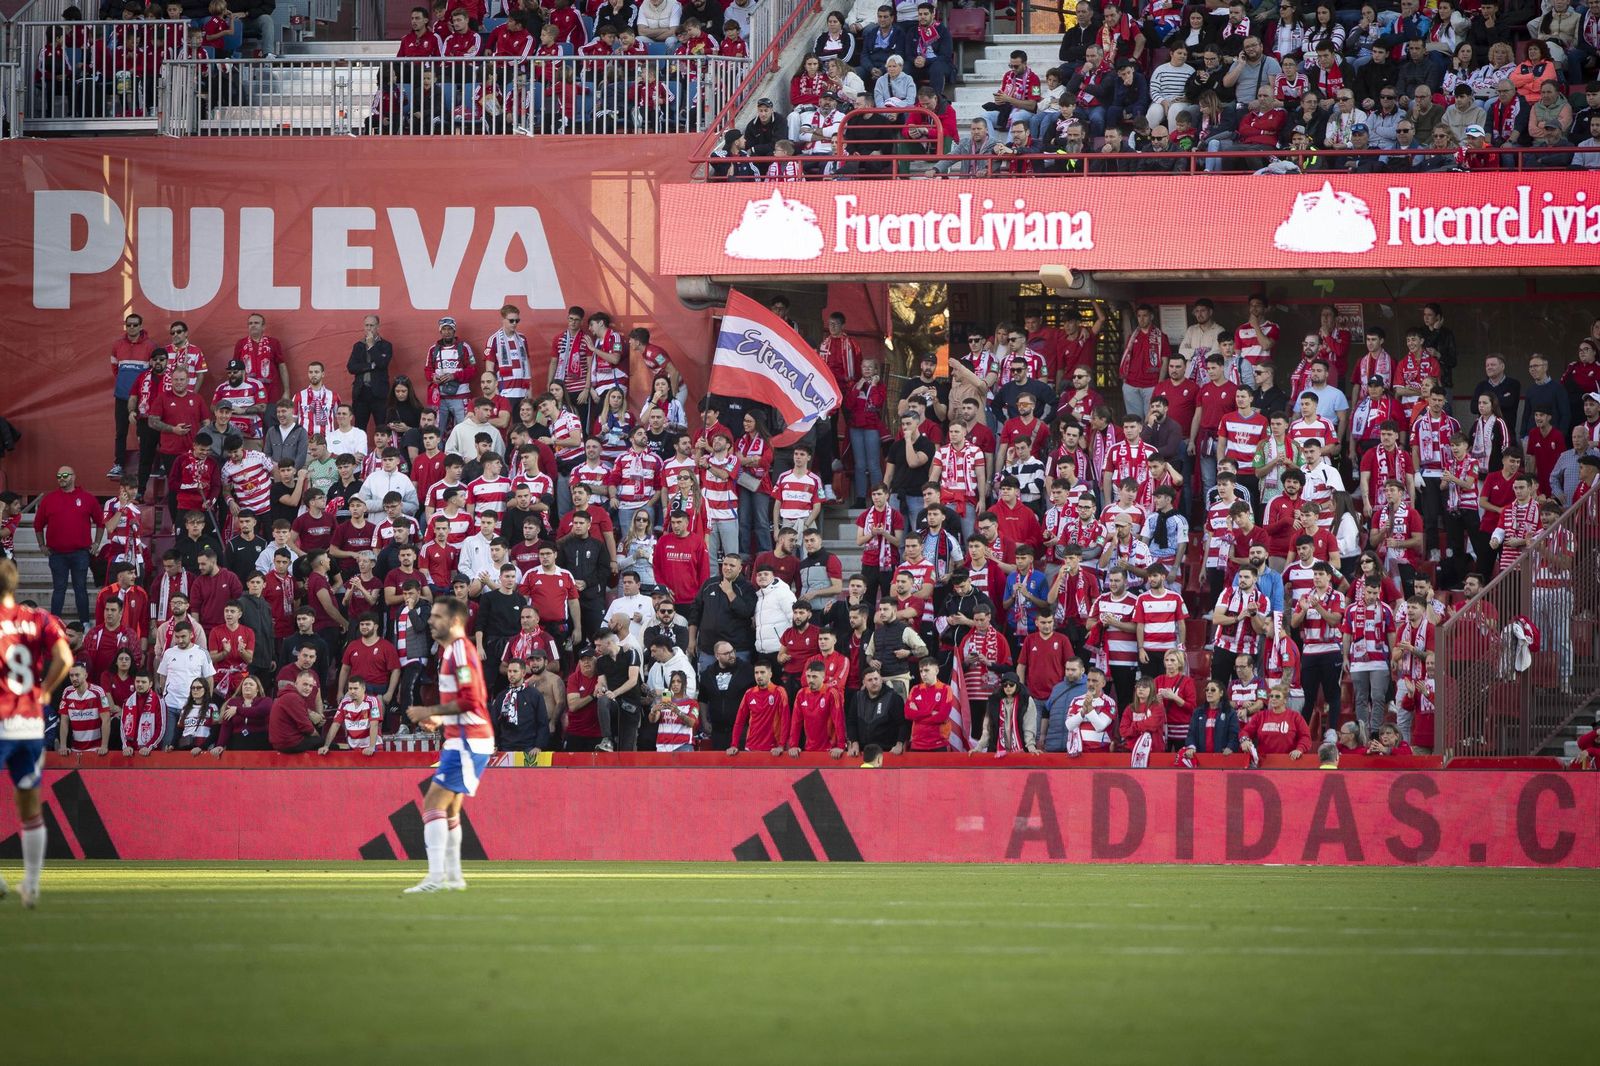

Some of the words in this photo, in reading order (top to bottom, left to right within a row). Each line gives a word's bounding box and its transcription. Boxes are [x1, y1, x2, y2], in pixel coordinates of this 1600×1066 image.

[33, 189, 566, 310] PULEVA
[833, 192, 1095, 253] FuenteLiviana
[736, 329, 799, 390] Eterna
[5, 643, 35, 695] 8
